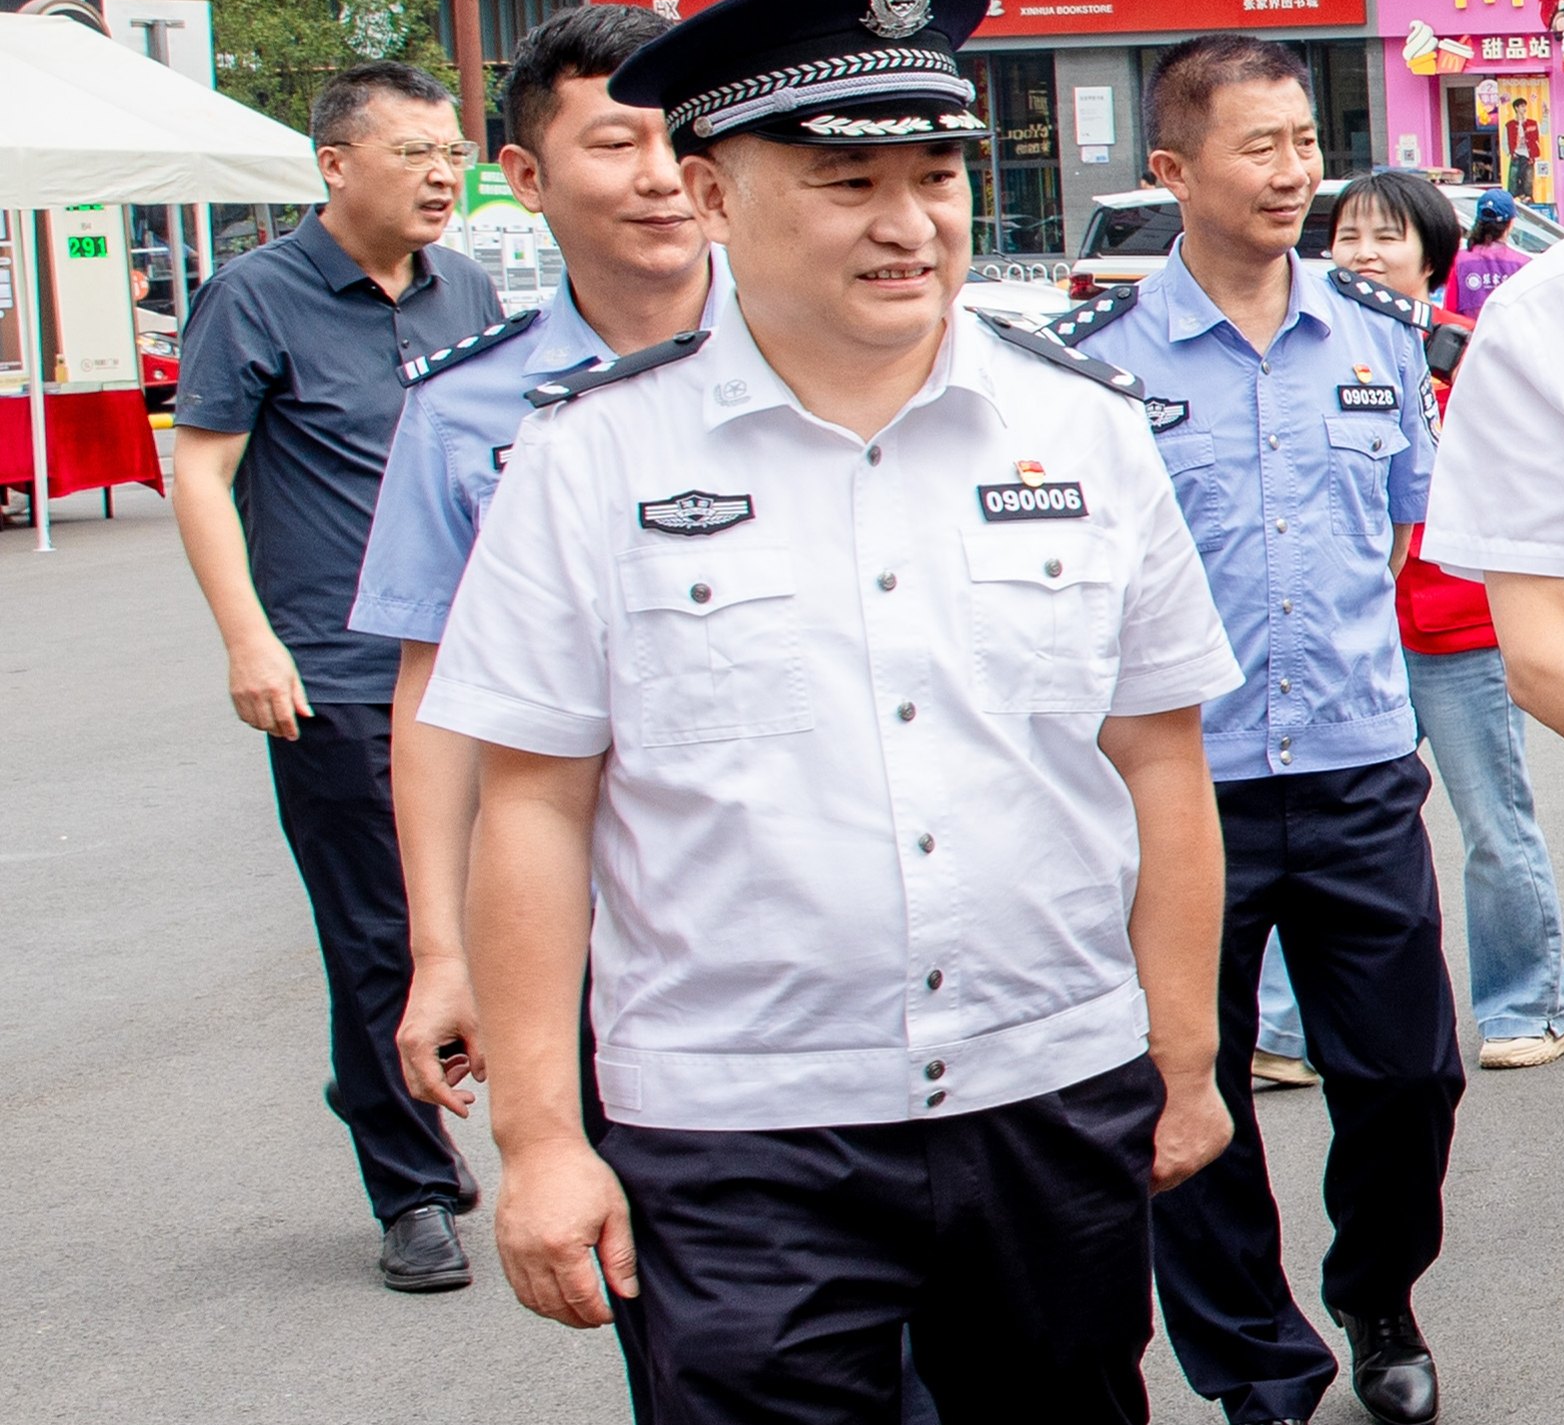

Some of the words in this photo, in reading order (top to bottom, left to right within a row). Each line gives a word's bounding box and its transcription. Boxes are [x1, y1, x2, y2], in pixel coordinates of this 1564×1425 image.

[1481, 37, 1550, 60] 甜品站
[1342, 388, 1394, 407] 090328
[987, 489, 1081, 512] 090006
